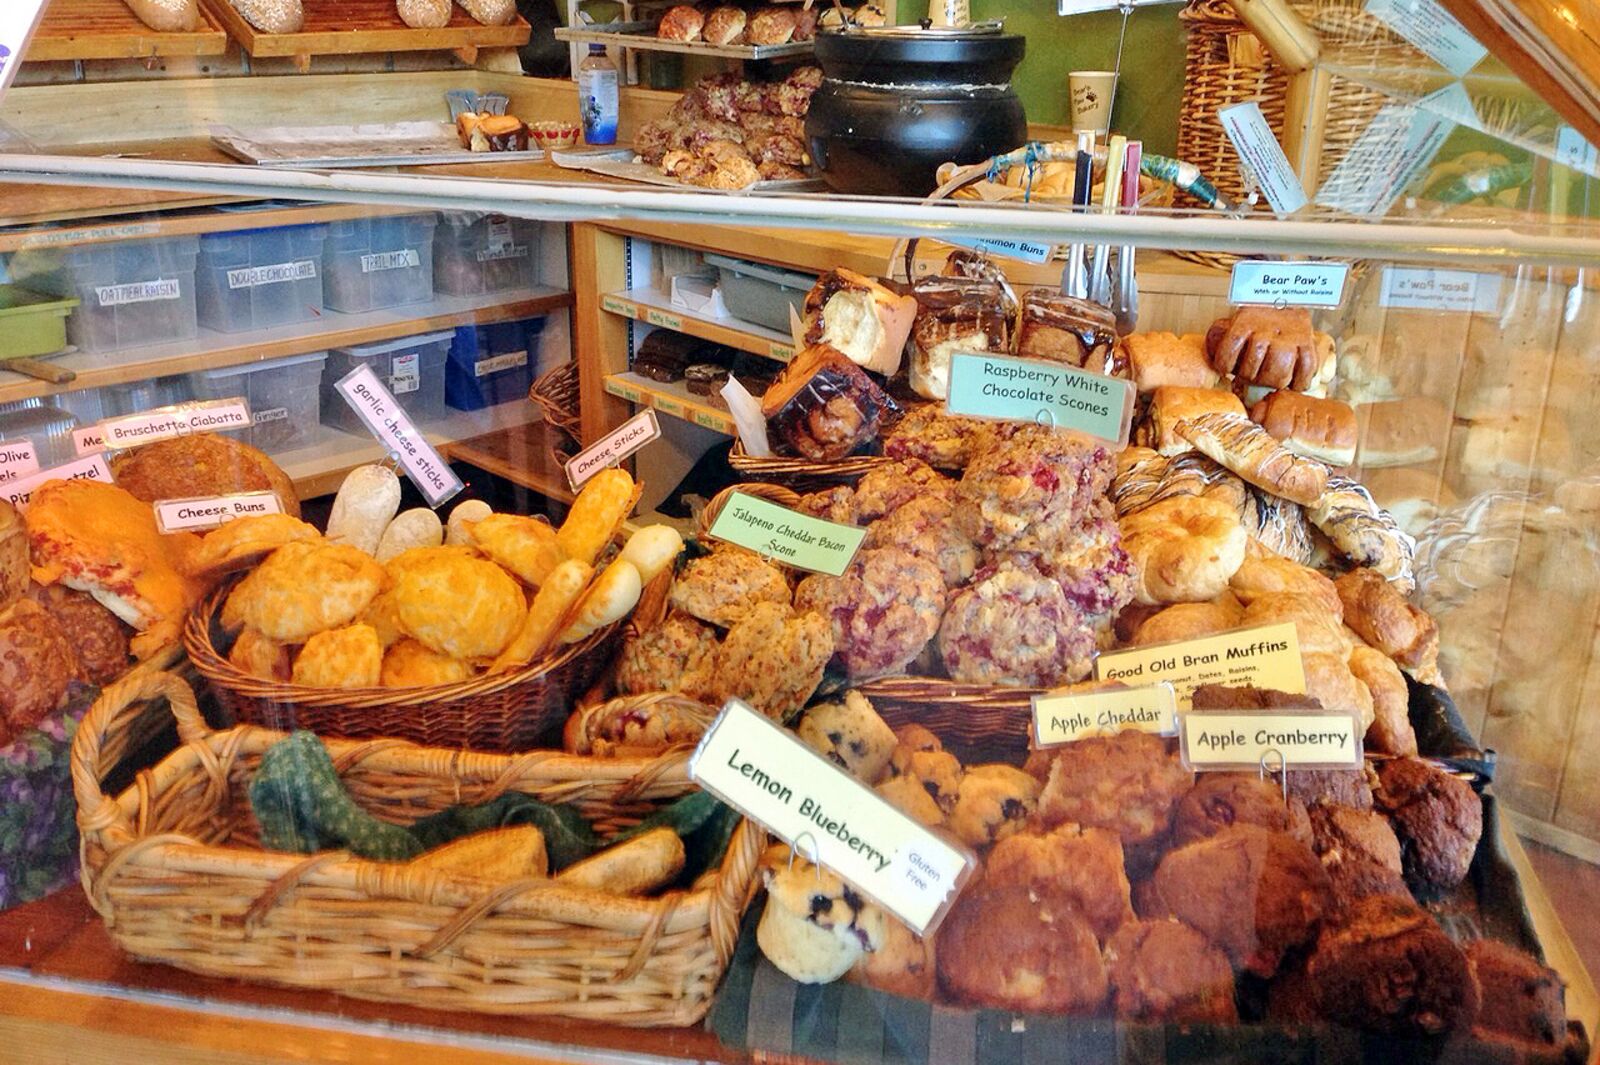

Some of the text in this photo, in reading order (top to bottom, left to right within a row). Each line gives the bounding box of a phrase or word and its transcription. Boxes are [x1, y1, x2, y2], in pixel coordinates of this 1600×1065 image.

[1019, 242, 1045, 256] Buns
[1262, 274, 1328, 286] Bear Paw's
[984, 362, 1110, 396] Raspberry White
[982, 383, 1110, 417] Chocolate Scones
[113, 413, 243, 439] Bruschetta Ciabatta
[353, 383, 385, 416] garlic
[384, 418, 417, 456] cheese
[416, 457, 445, 491] sticks
[0, 451, 31, 464] Olive
[578, 425, 646, 474] Cheese Sticks
[10, 490, 34, 508] Piz
[178, 501, 266, 519] Cheese Buns
[732, 507, 846, 552] Jalapeno Cheddar Bacon
[769, 538, 797, 557] Scone
[1106, 638, 1288, 680] Good Old Bran Muffins
[1050, 707, 1162, 735] Apple Cheddar
[1197, 728, 1348, 750] Apple Cranberry
[727, 747, 892, 874] Lemon Blueberry
[905, 868, 928, 892] Free
[907, 851, 941, 883] Gluten
